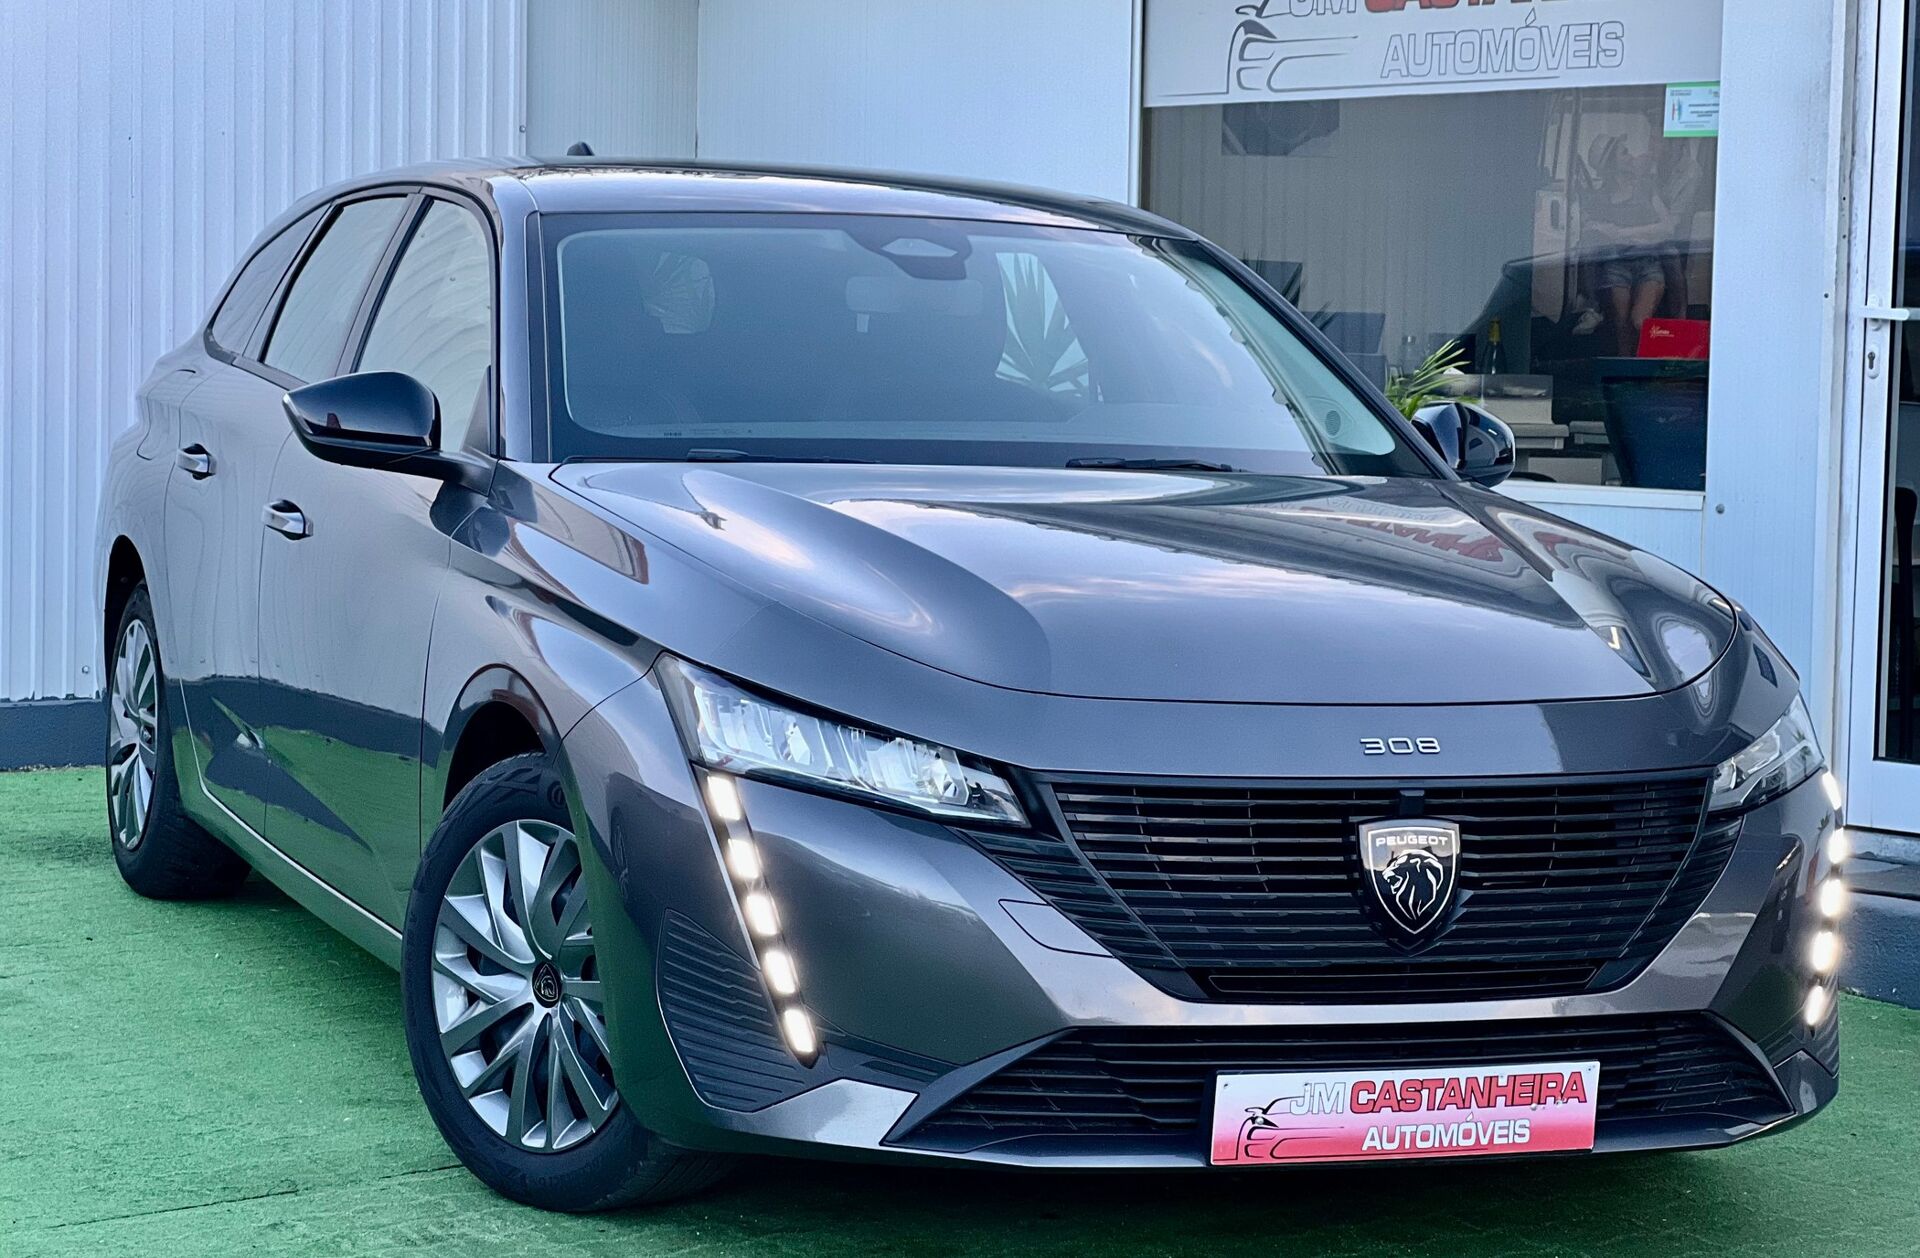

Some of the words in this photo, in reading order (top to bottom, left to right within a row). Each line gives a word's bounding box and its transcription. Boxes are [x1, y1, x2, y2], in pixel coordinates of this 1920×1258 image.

[1380, 7, 1625, 79] AUTOMÓVEIS
[1360, 737, 1441, 755] 308
[1375, 834, 1449, 848] PEUGEOT
[1289, 1081, 1346, 1115] JM
[1350, 1071, 1588, 1115] CASTANHEIRA
[1361, 1111, 1531, 1151] AUTOMÓVEIS
